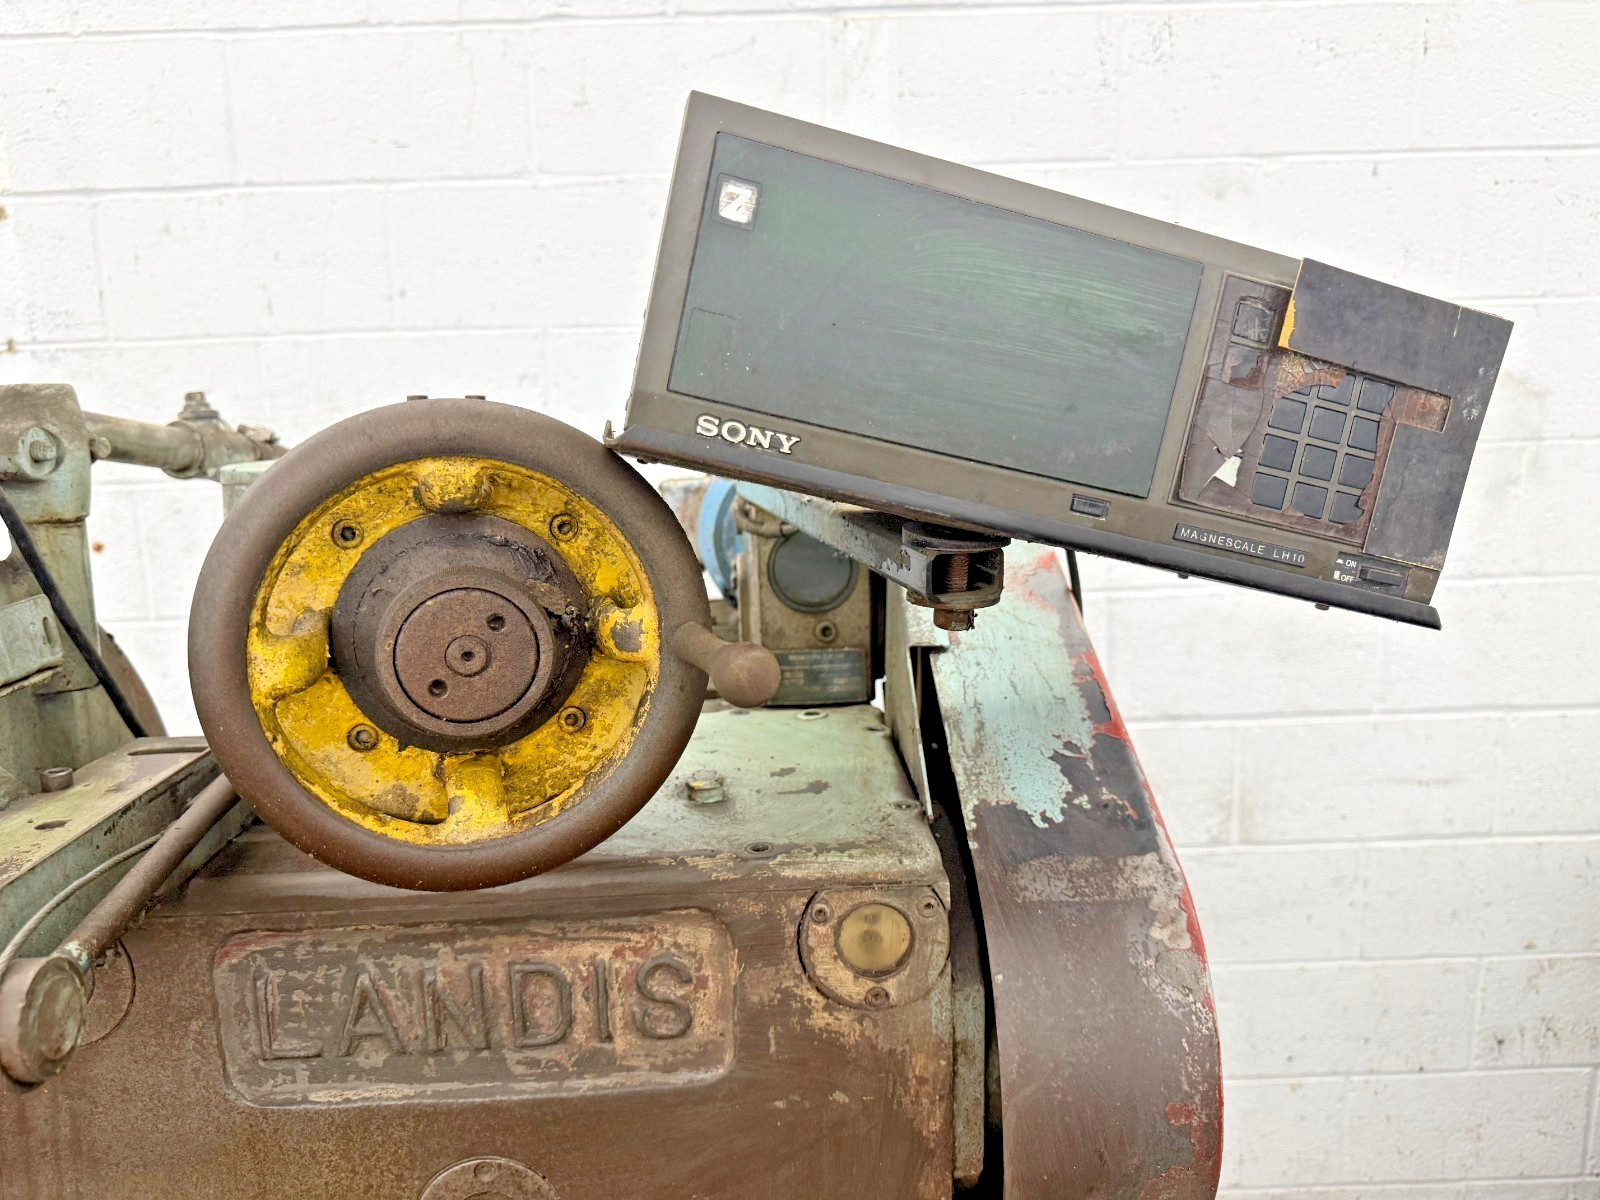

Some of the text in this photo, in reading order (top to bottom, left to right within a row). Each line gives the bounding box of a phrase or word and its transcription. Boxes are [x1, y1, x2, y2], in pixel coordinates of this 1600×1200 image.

[696, 415, 800, 454] SONY
[1180, 527, 1305, 563] MAGNESCALE LH10
[1340, 574, 1355, 582] OFF
[1345, 559, 1357, 568] ON
[253, 953, 695, 1061] LANDIS
